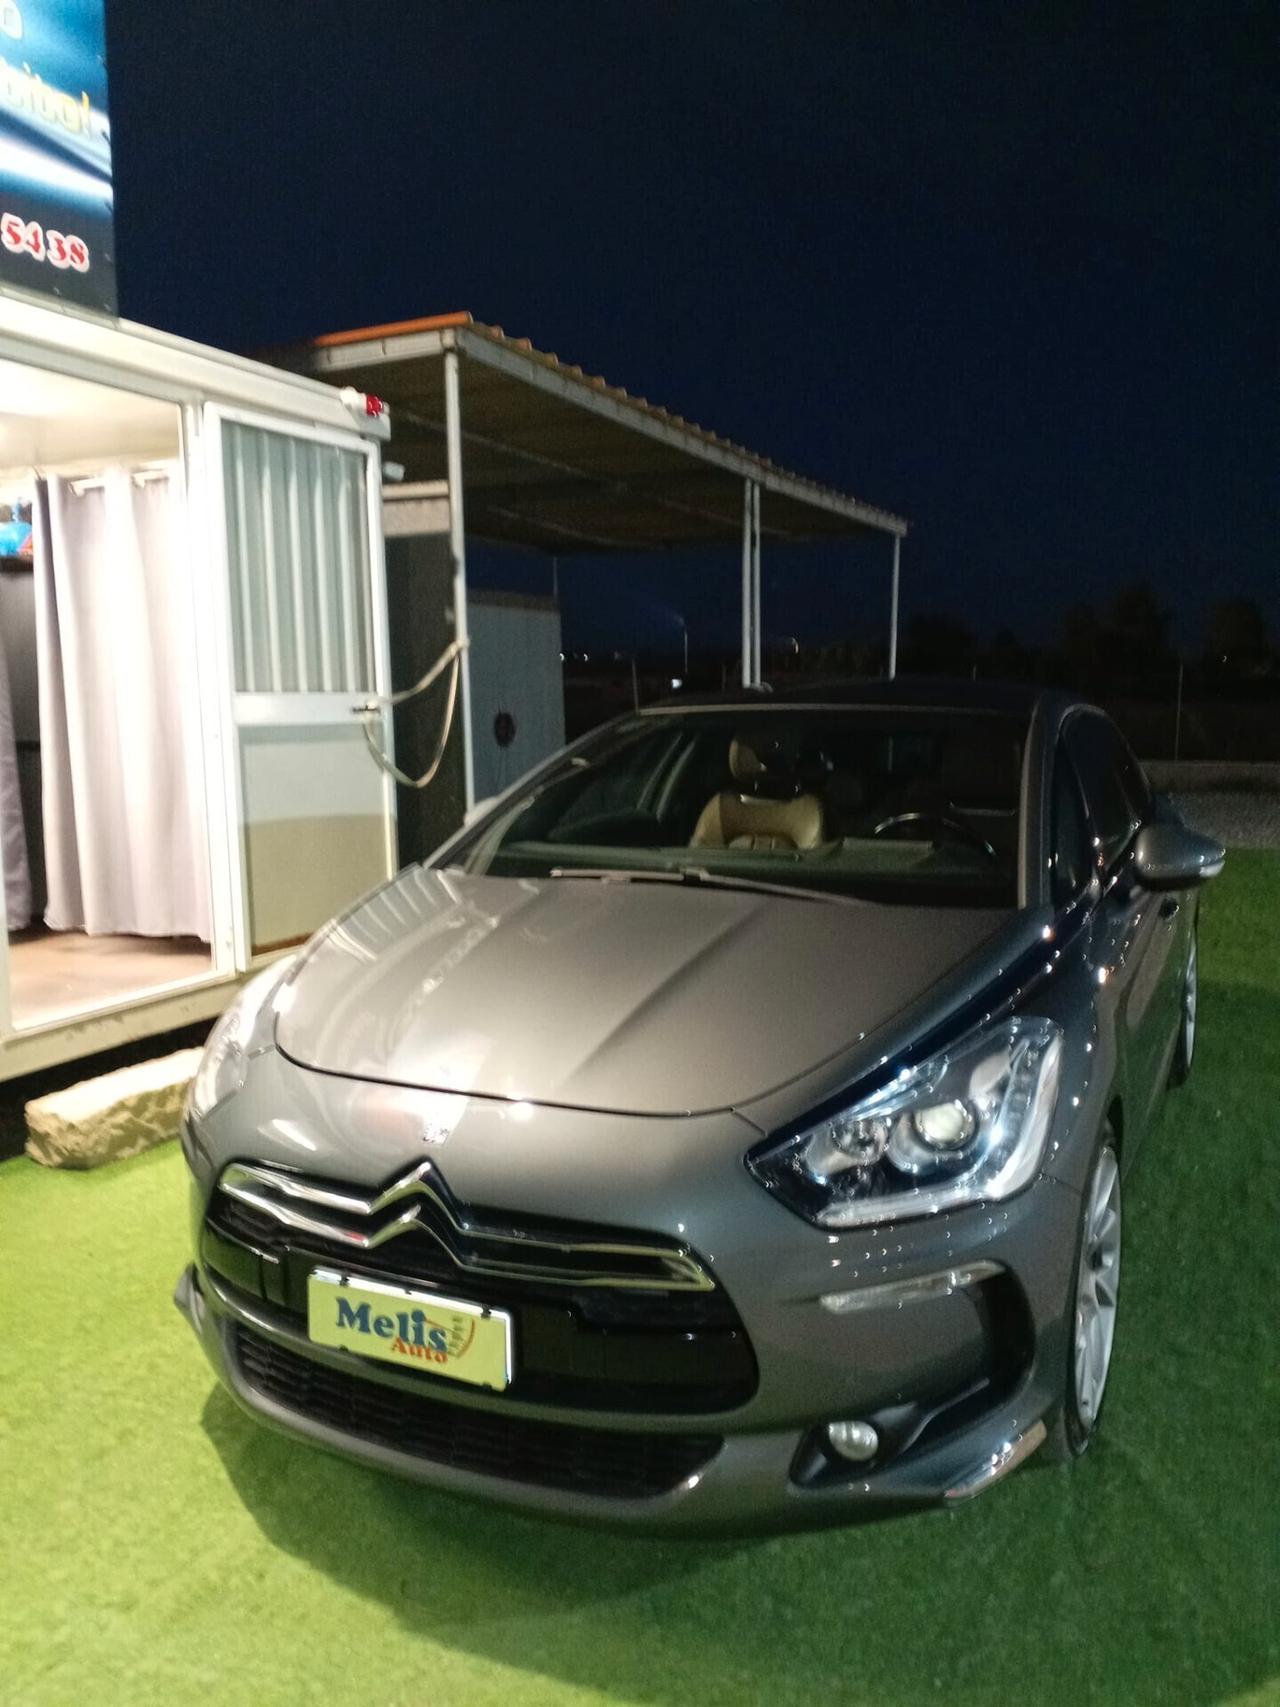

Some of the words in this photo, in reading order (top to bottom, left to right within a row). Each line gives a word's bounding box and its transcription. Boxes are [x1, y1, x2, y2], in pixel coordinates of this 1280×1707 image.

[1, 212, 90, 273] 5438
[336, 1297, 448, 1353] Melis
[391, 1336, 449, 1364] Auto
